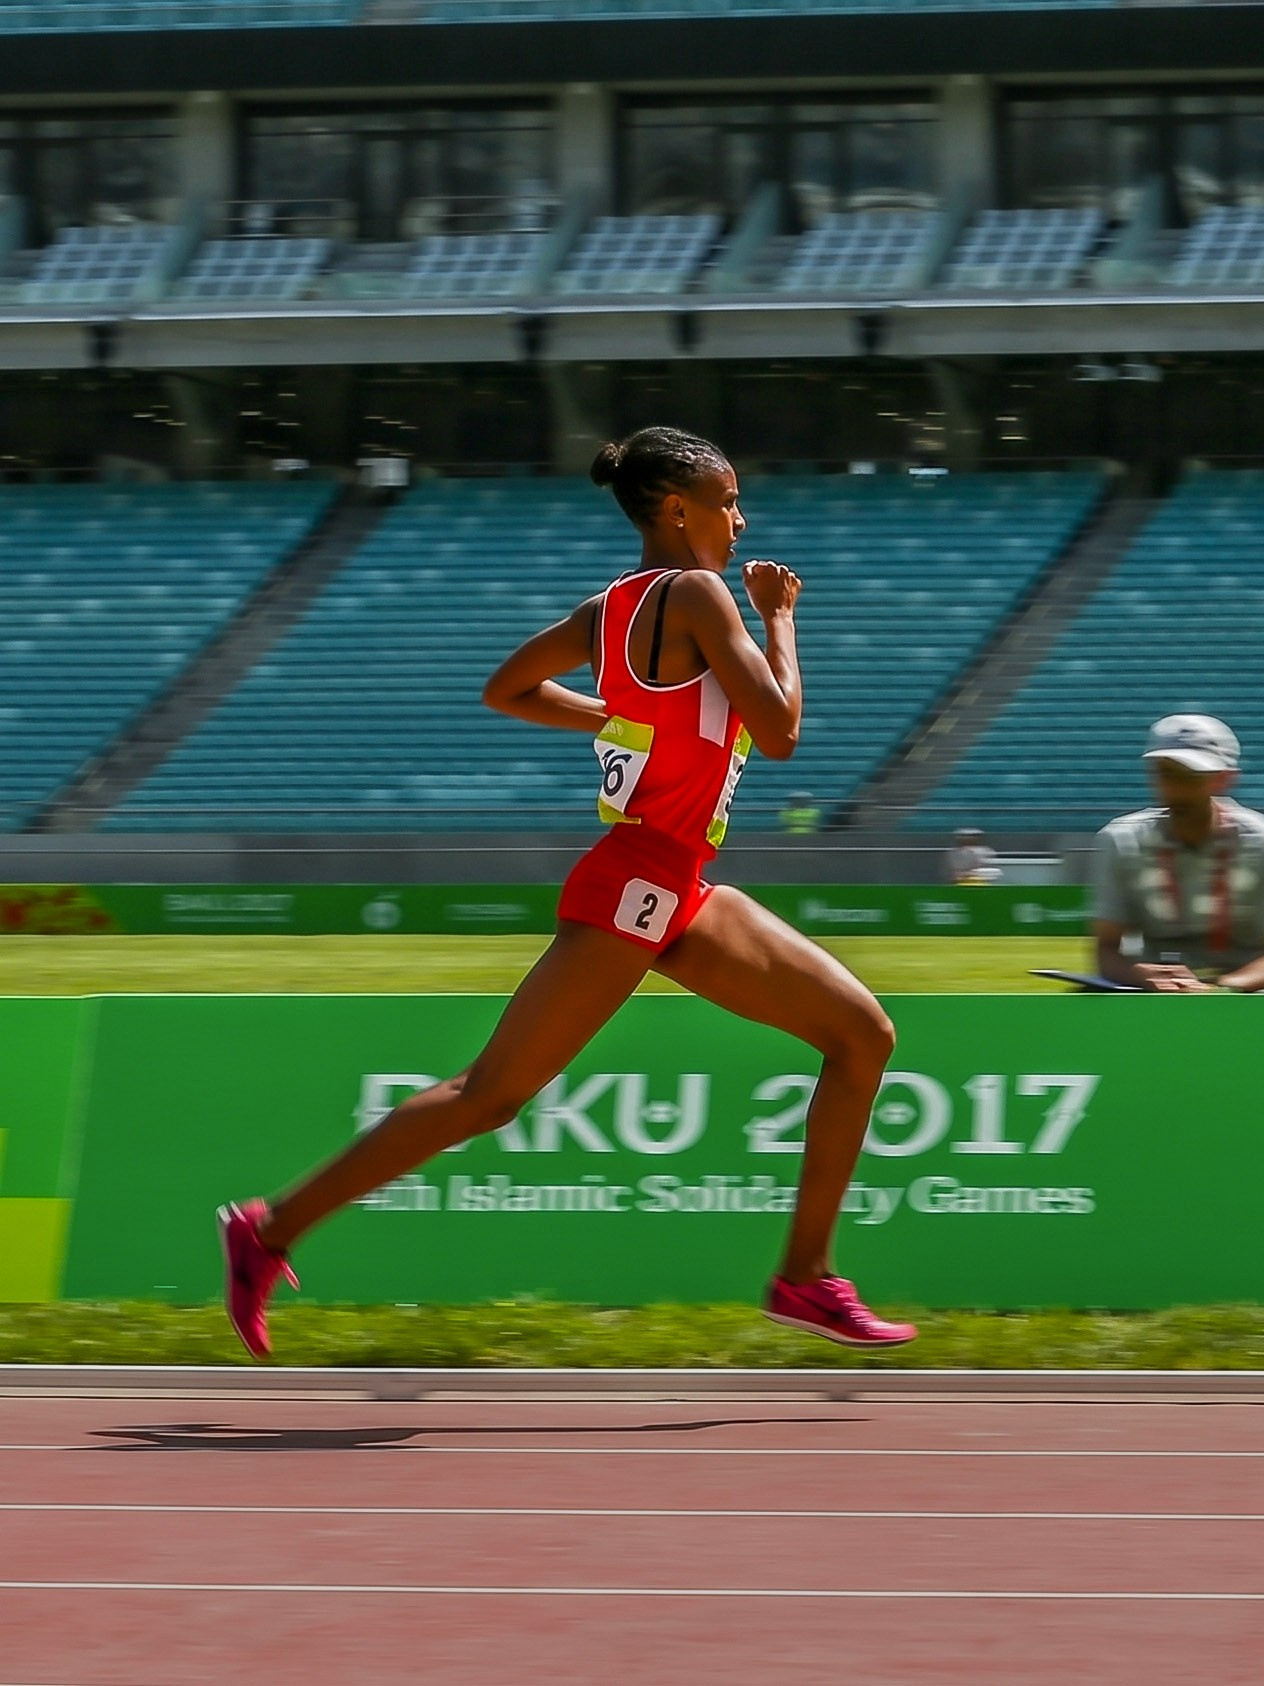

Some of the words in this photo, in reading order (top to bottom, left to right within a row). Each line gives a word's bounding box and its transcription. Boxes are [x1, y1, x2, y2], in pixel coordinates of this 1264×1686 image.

[634, 892, 659, 931] 2
[743, 1071, 1102, 1157] 2017
[446, 1174, 633, 1212] Islamic
[635, 1174, 904, 1225] Solidaty
[906, 1175, 1097, 1214] Games
